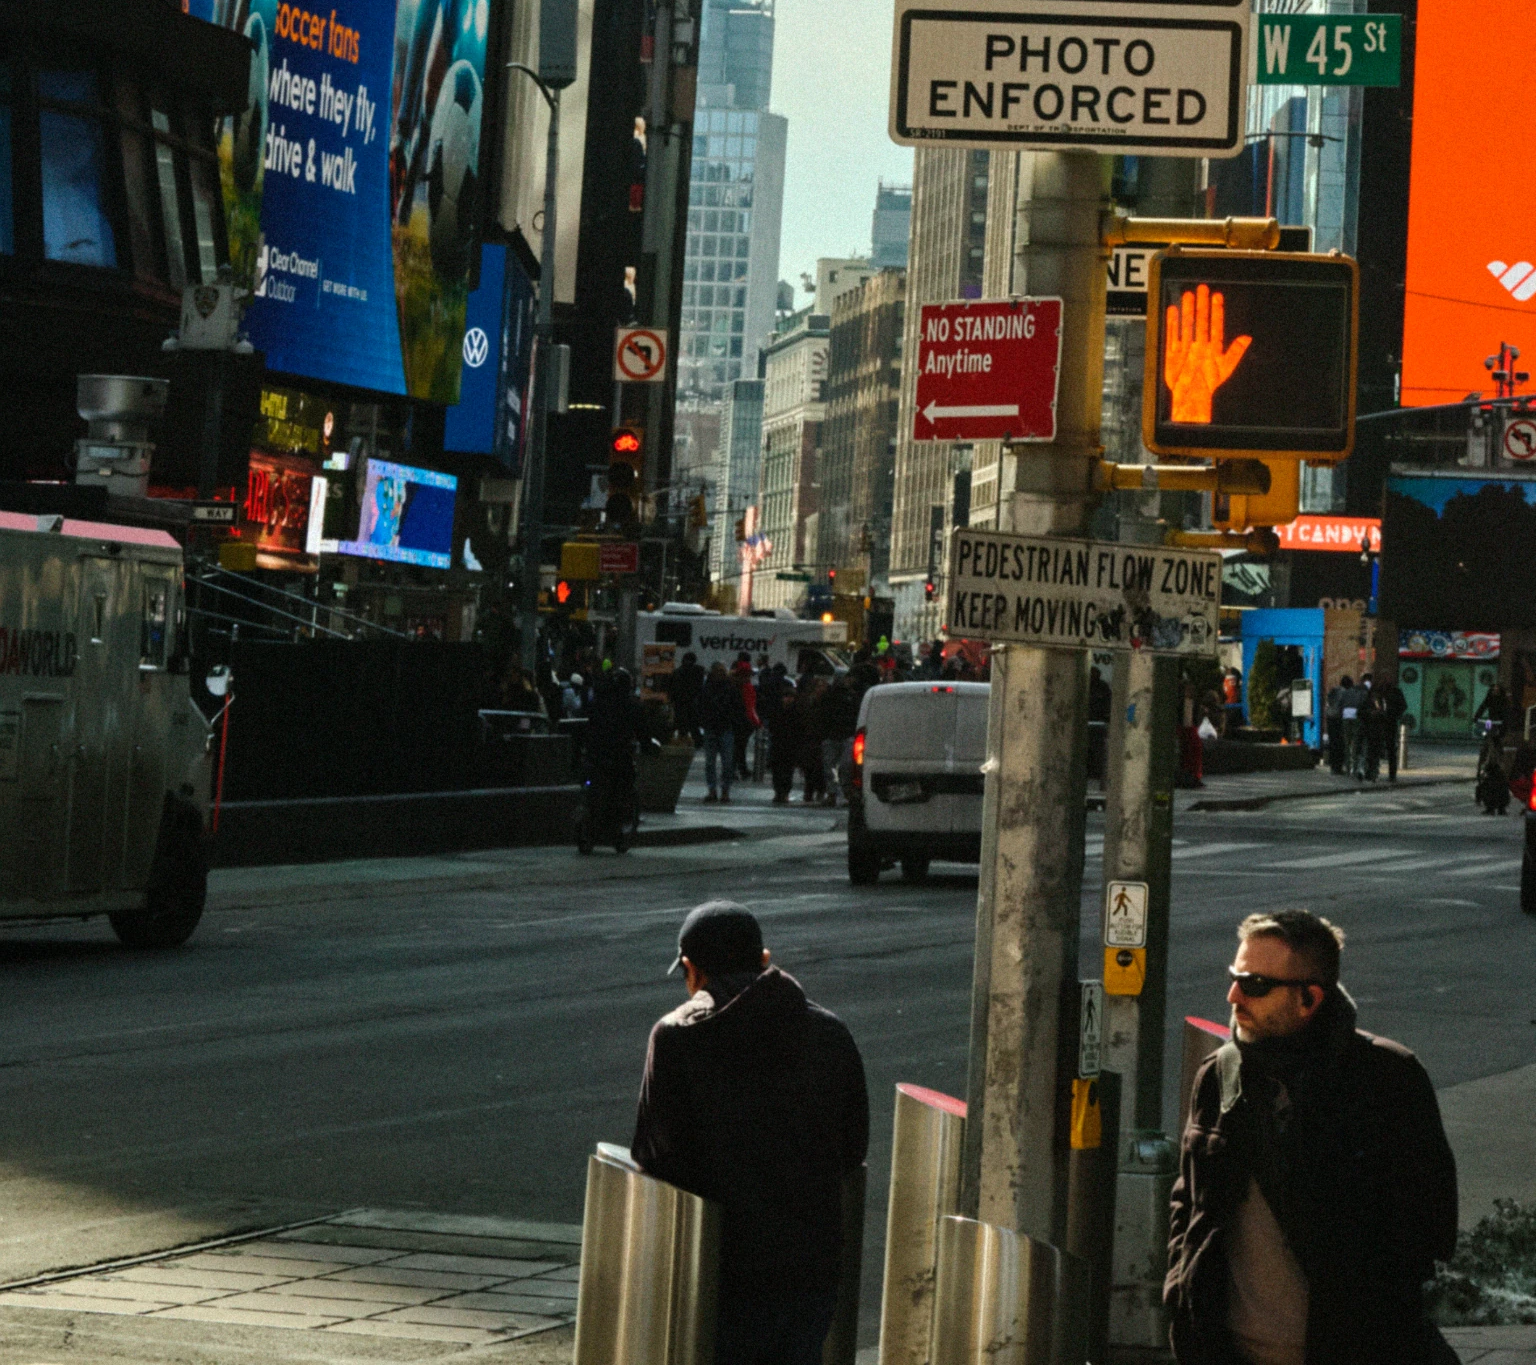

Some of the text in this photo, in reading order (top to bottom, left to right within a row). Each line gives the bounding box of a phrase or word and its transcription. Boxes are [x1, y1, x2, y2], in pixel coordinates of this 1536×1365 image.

[328, 9, 361, 65] fans
[984, 34, 1155, 77] PHOTO
[1264, 23, 1387, 76] W 45 St
[269, 58, 377, 145] where they fly,
[928, 80, 1207, 126] ENFORCED
[1049, 124, 1127, 135] TRNSPORTATION
[264, 122, 358, 195] drive & walk
[270, 246, 319, 279] Clear Channel
[267, 275, 297, 303] Outdoor
[926, 314, 1037, 342] NO STANDING
[925, 349, 993, 379] Anytime
[206, 508, 228, 519] WAY
[958, 538, 1218, 598] PEDESTRIAN FLOW ZONE
[953, 590, 1098, 639] KEEP MOVING
[699, 632, 770, 652] verizon
